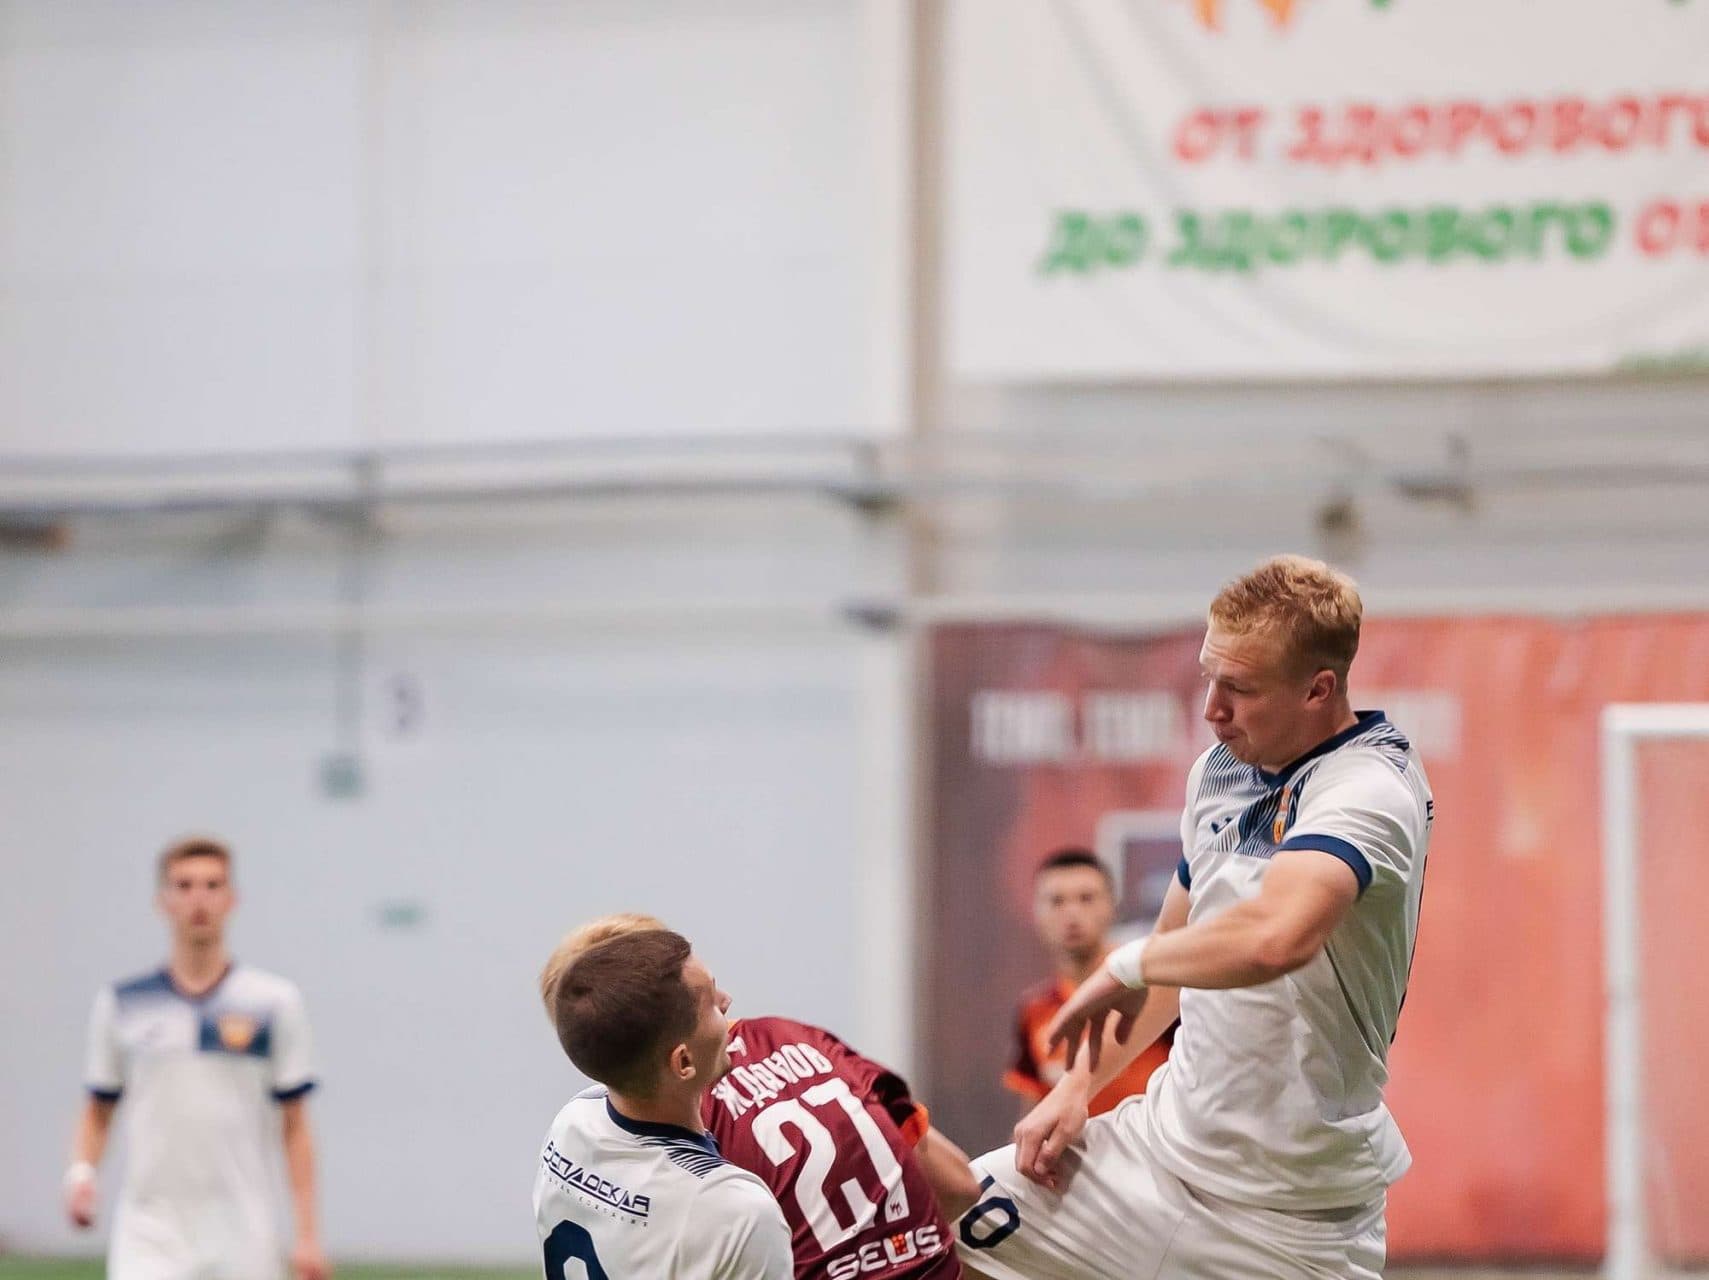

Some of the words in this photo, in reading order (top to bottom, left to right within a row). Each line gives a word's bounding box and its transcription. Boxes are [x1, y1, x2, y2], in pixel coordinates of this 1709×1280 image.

[1173, 107, 1266, 164] ОТ
[1043, 211, 1148, 273] ДО
[1168, 201, 1614, 275] ЗДОРОВОГО
[711, 1042, 833, 1121] ЖДАНОВ
[751, 1077, 911, 1253] 27
